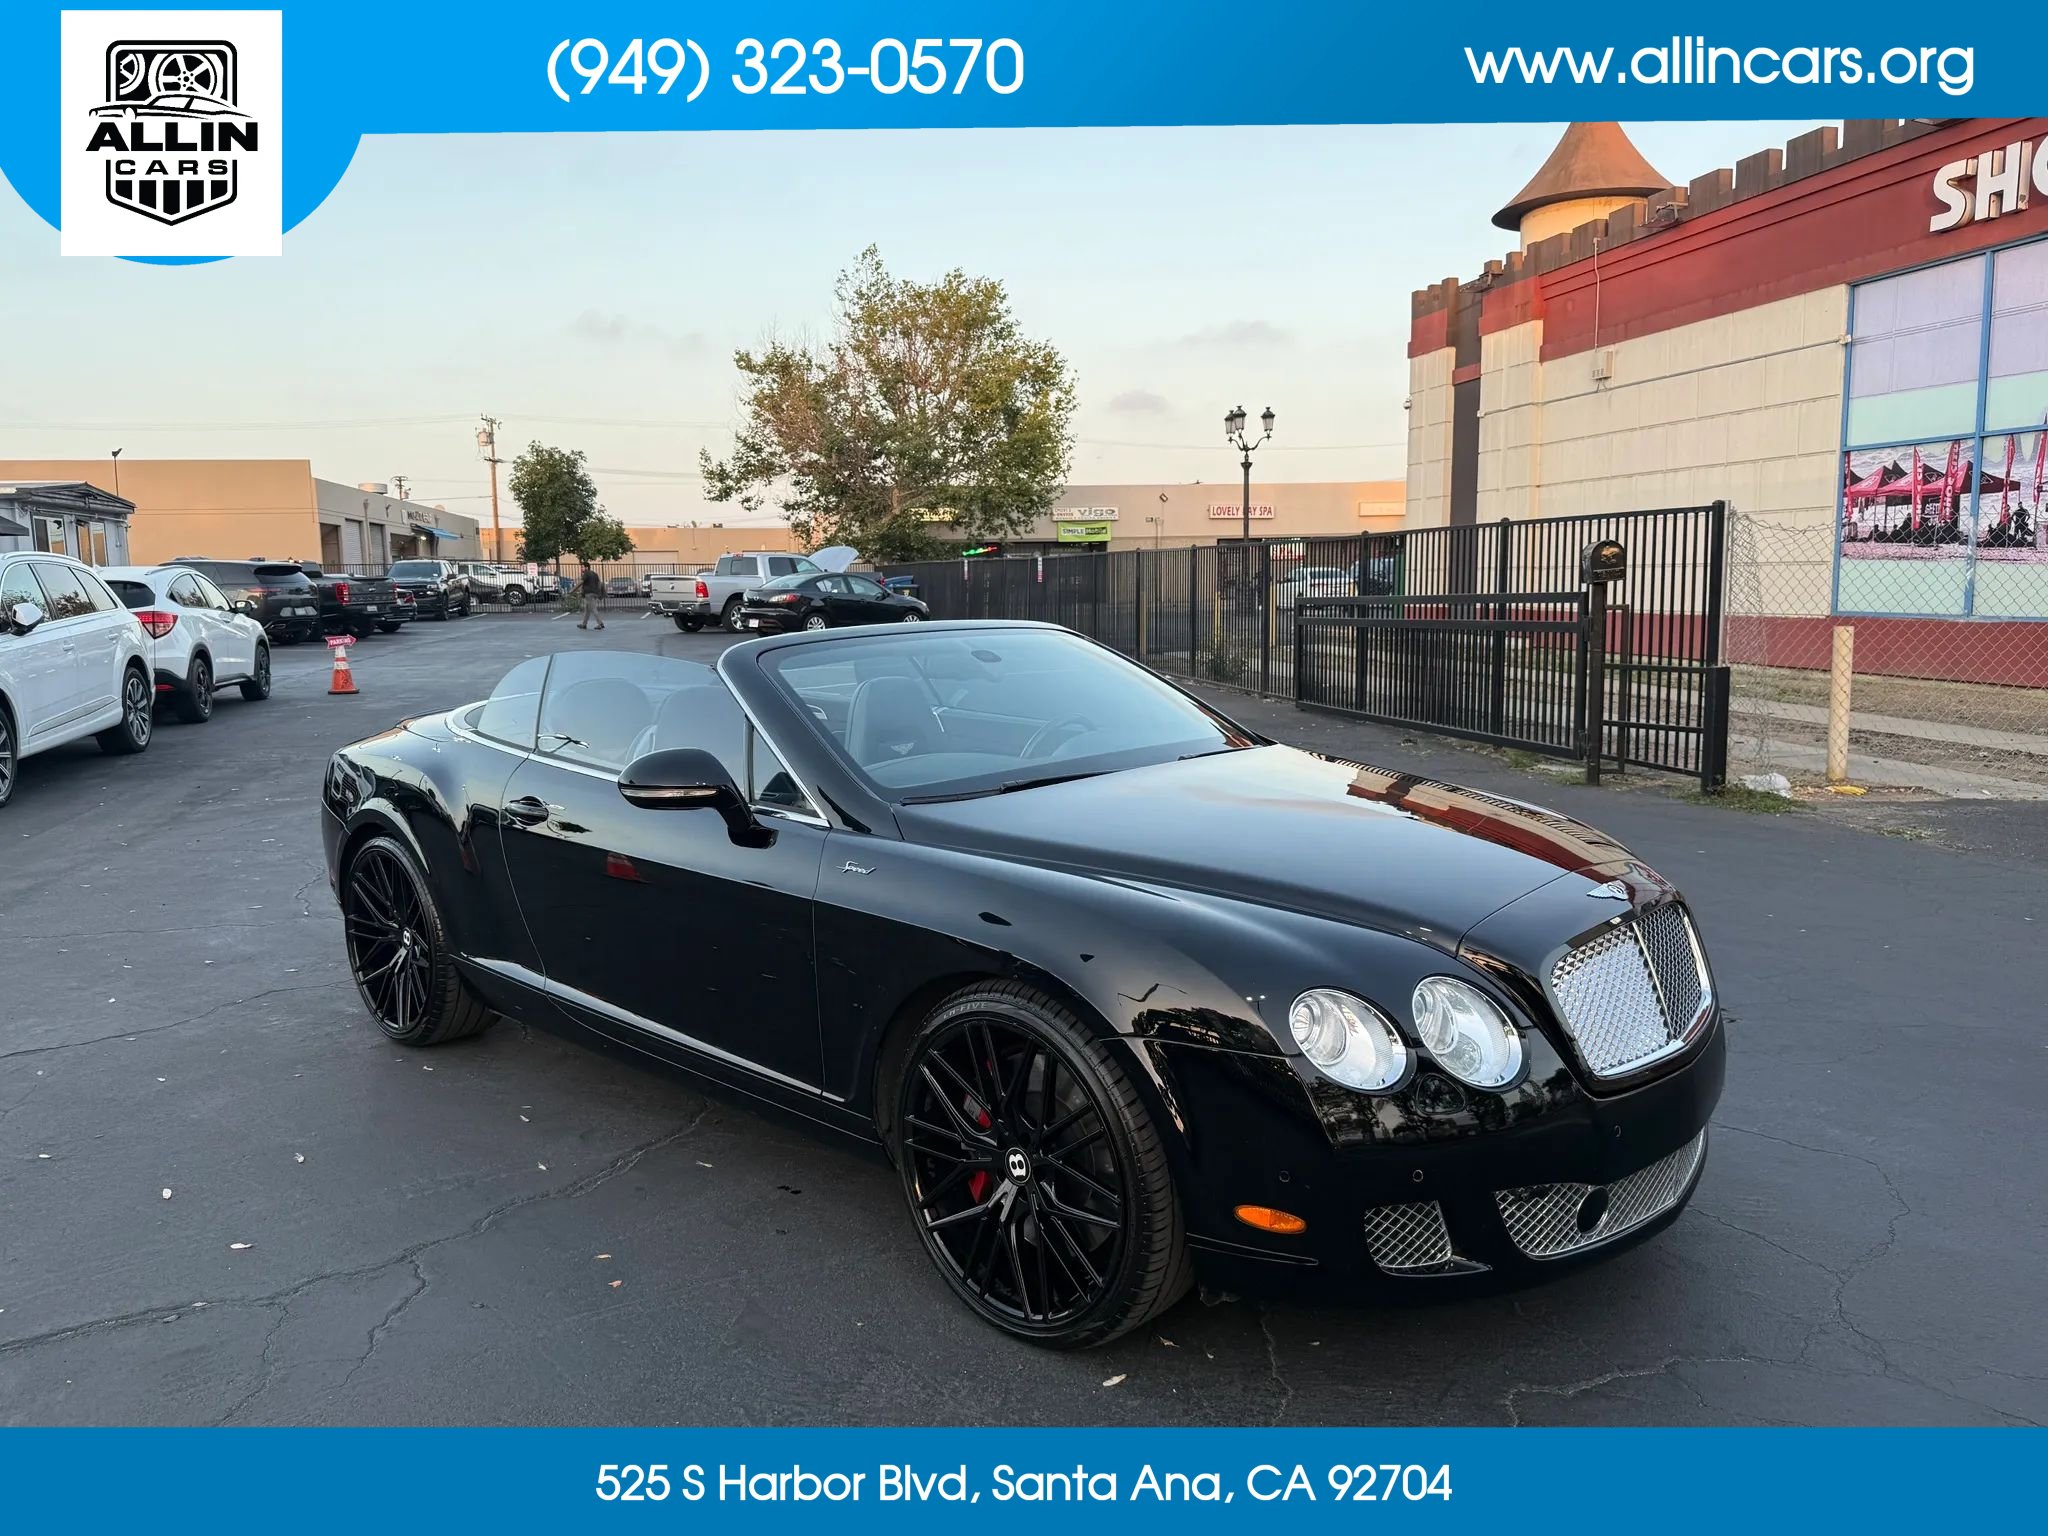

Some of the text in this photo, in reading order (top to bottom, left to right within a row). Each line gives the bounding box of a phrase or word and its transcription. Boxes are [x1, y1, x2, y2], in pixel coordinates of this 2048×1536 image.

[1212, 506, 1273, 516] LOVELY AY SPA
